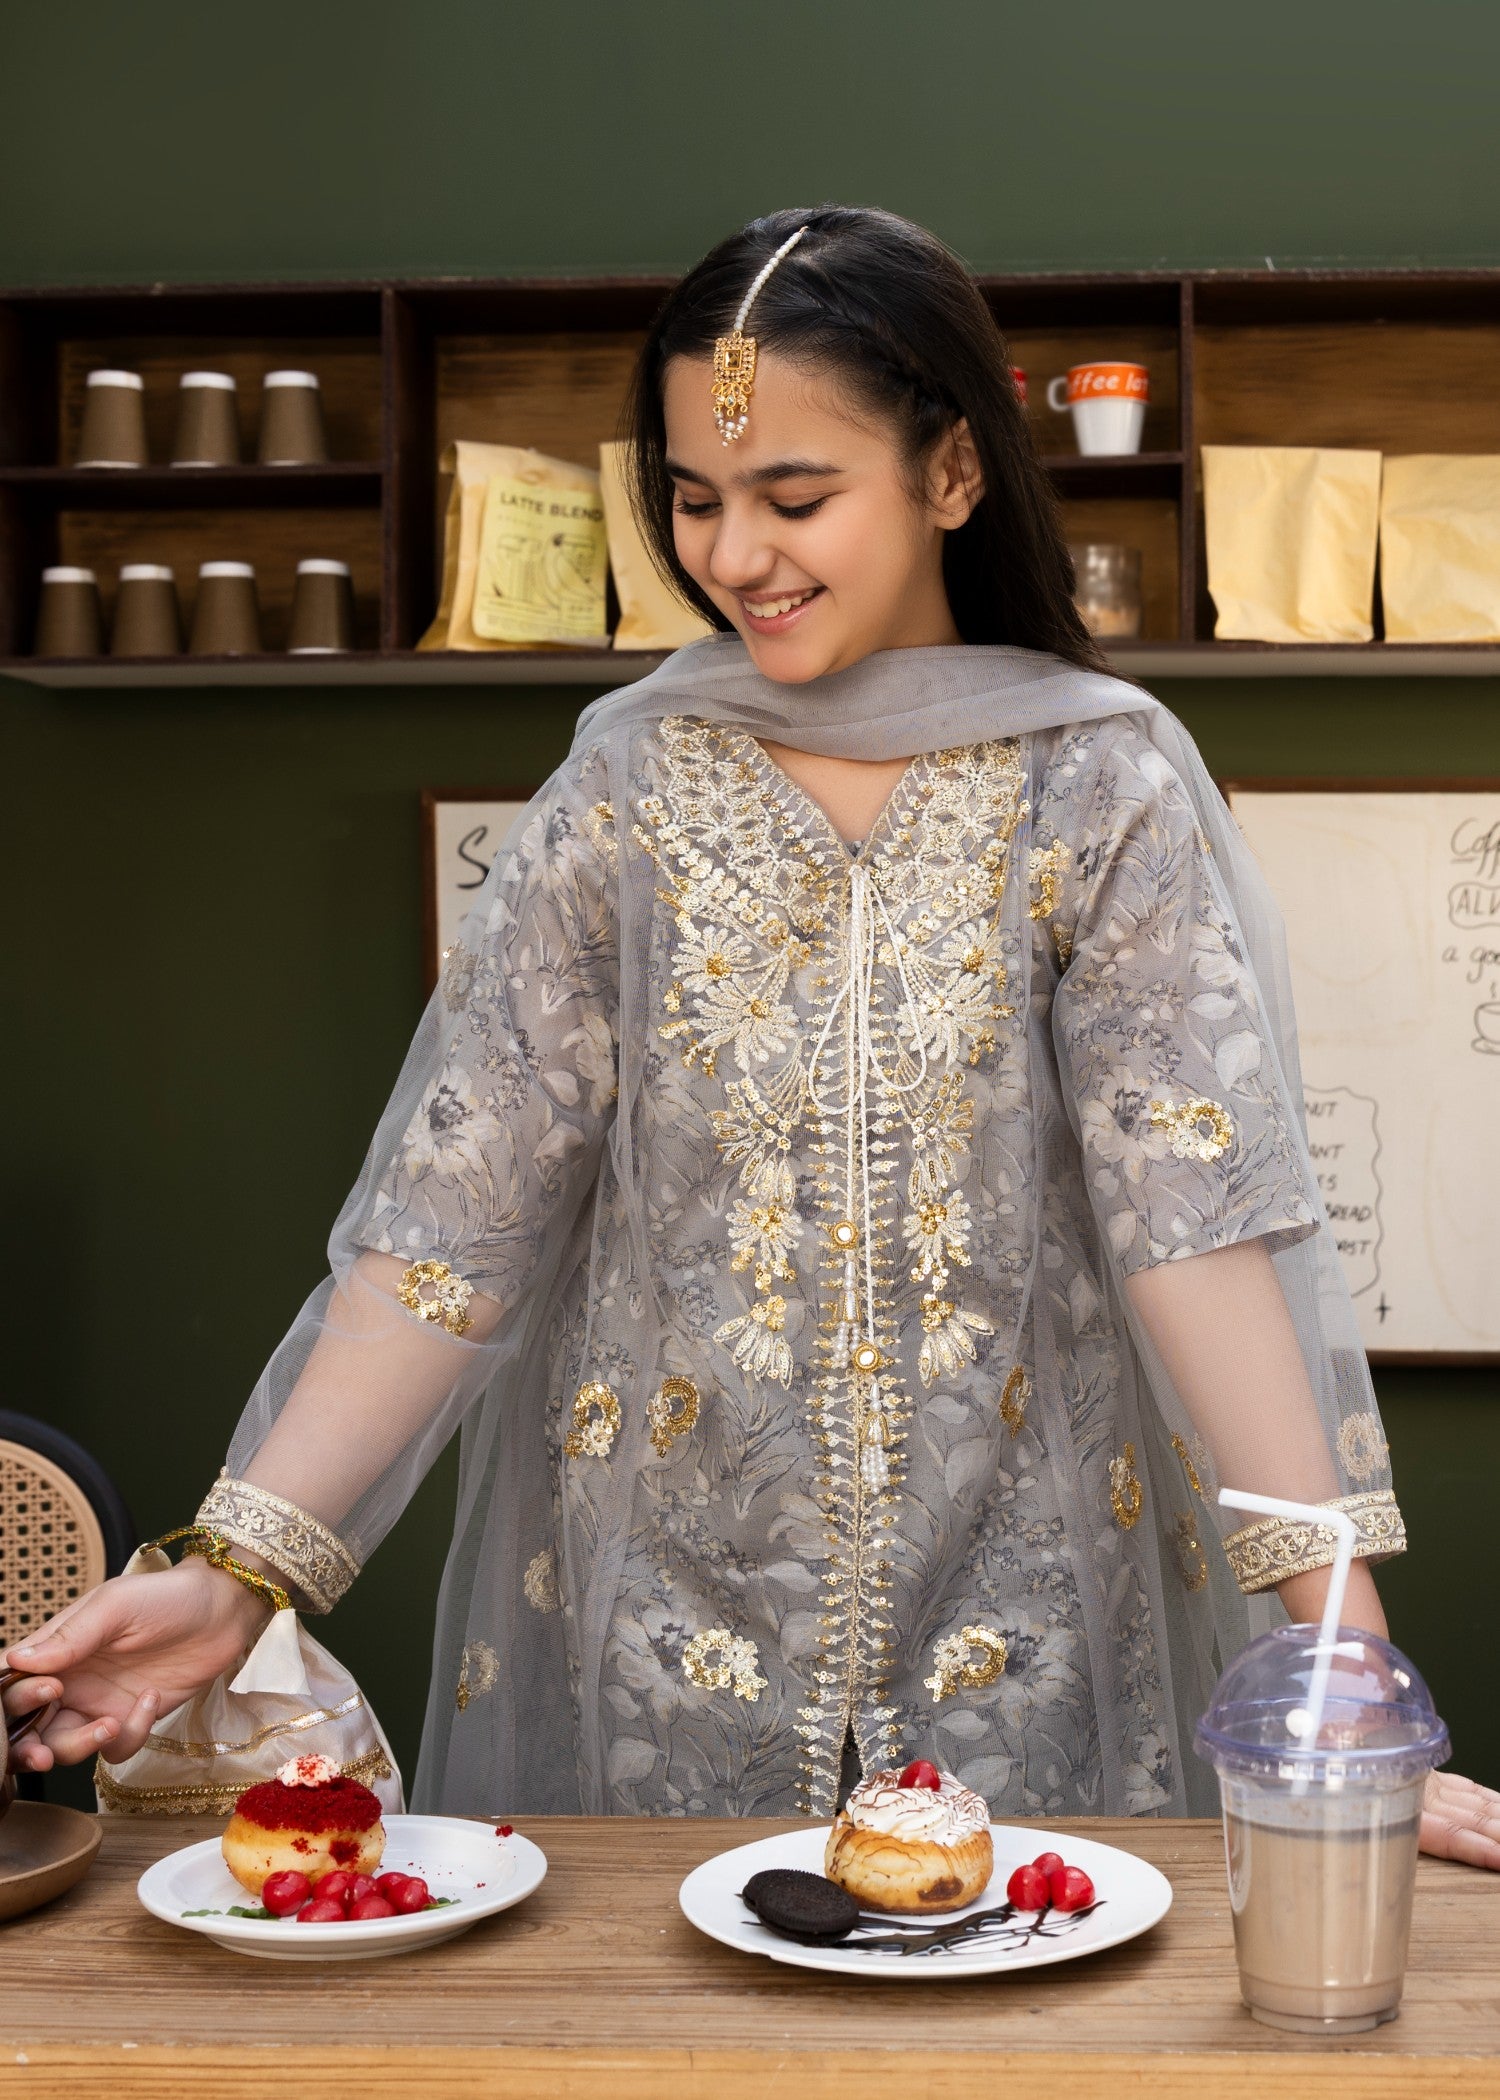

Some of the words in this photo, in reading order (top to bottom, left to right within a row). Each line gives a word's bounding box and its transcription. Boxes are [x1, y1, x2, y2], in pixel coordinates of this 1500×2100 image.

[501, 493, 543, 514] LATTE
[551, 504, 604, 522] BLEND
[1441, 945, 1459, 962] a
